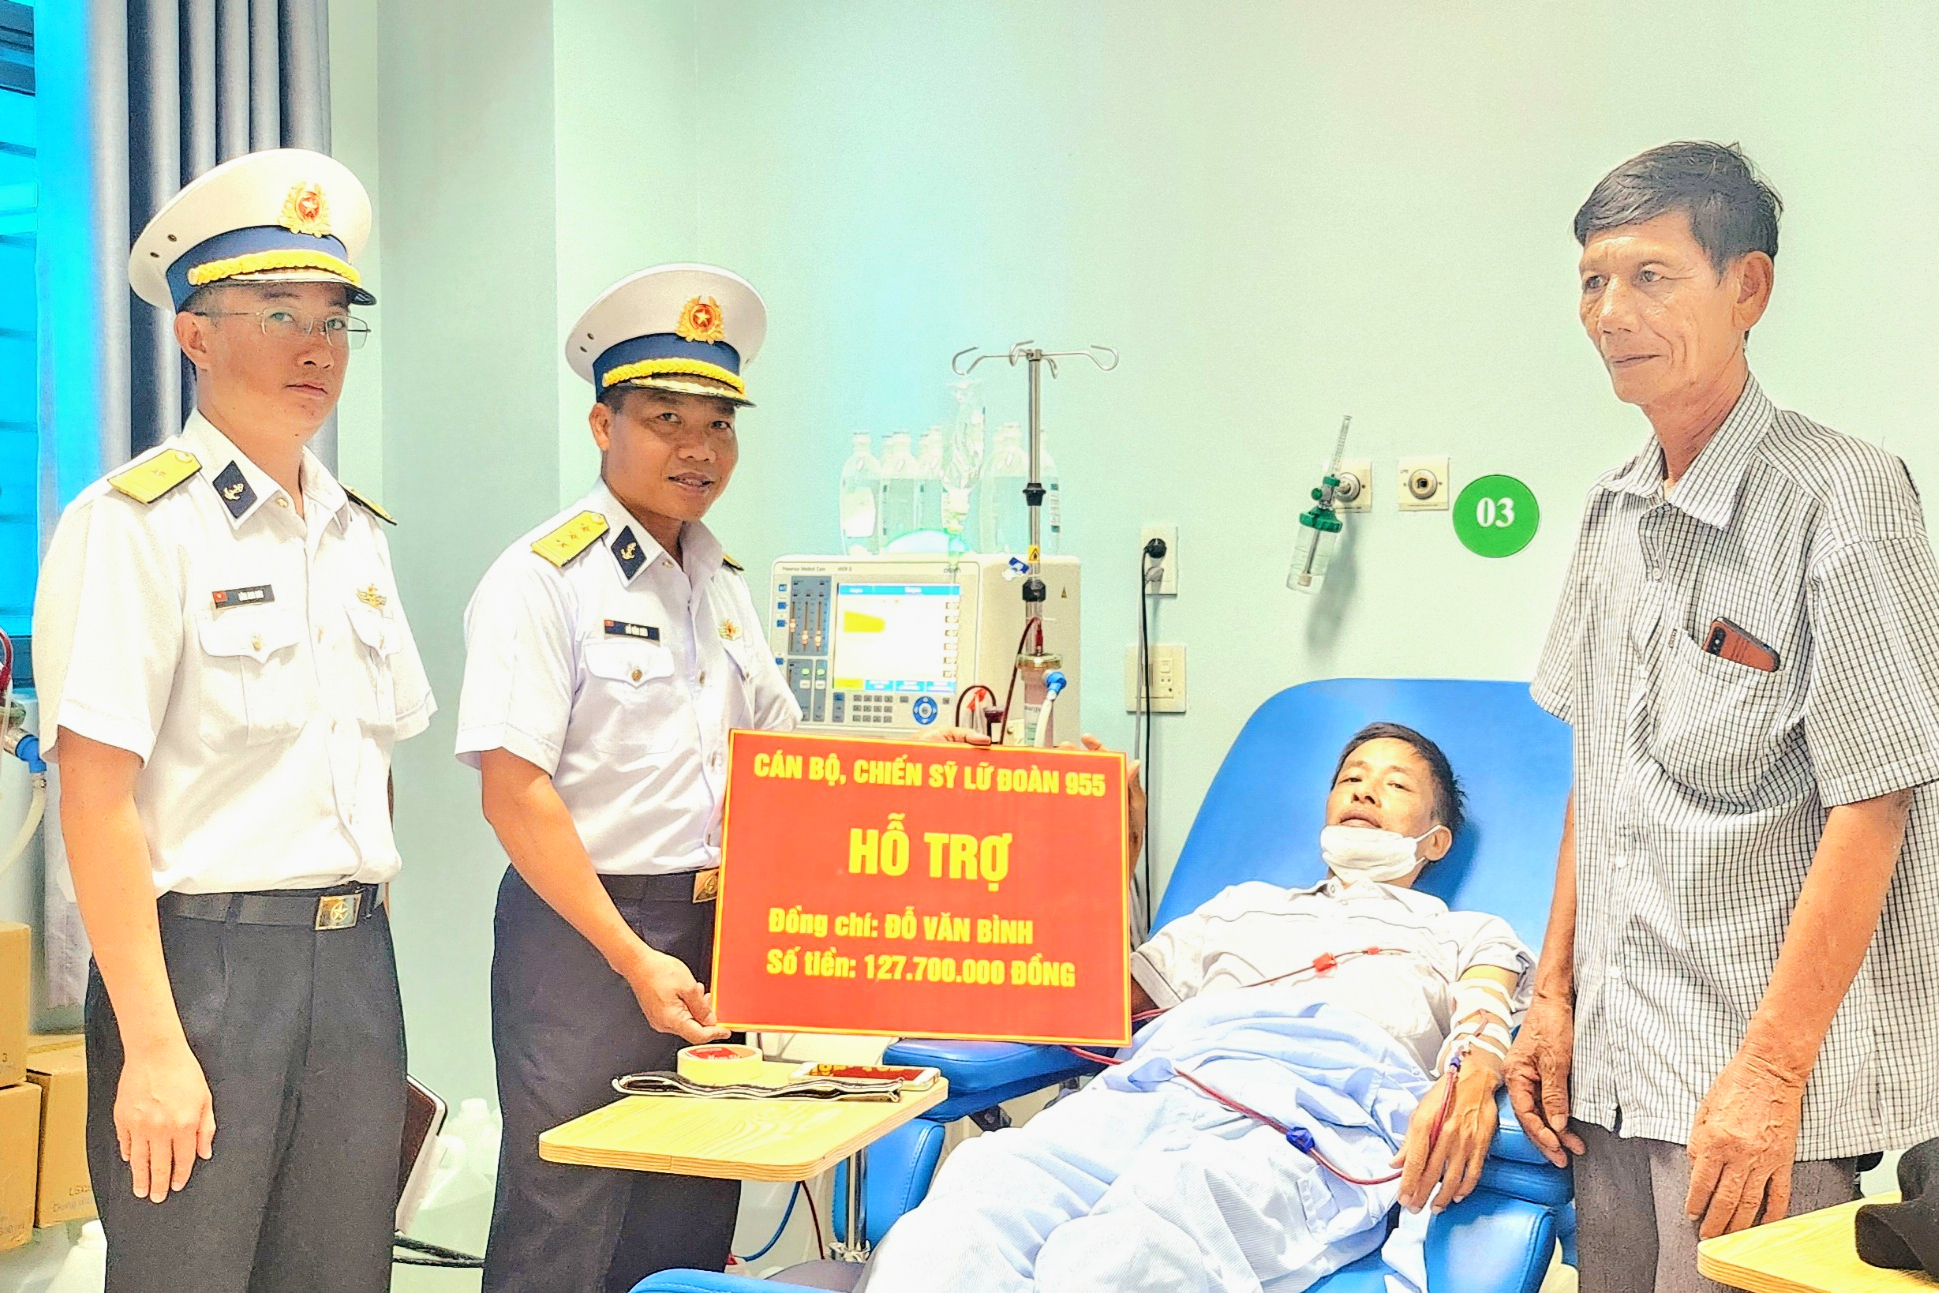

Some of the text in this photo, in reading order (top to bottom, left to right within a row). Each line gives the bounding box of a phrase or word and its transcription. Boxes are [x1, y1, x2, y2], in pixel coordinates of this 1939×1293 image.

[1476, 497, 1515, 527] 03
[754, 750, 1106, 797] CÁN BỘ, CHIẾN SỸ LỮ ĐOÀN 955
[849, 813, 1013, 892] HỖ TRỢ
[768, 905, 1034, 945] Đồng chí: ĐỖ VĂN BÌNH
[766, 946, 1076, 988] Số tiền: 127.700.000 ĐỒNG
